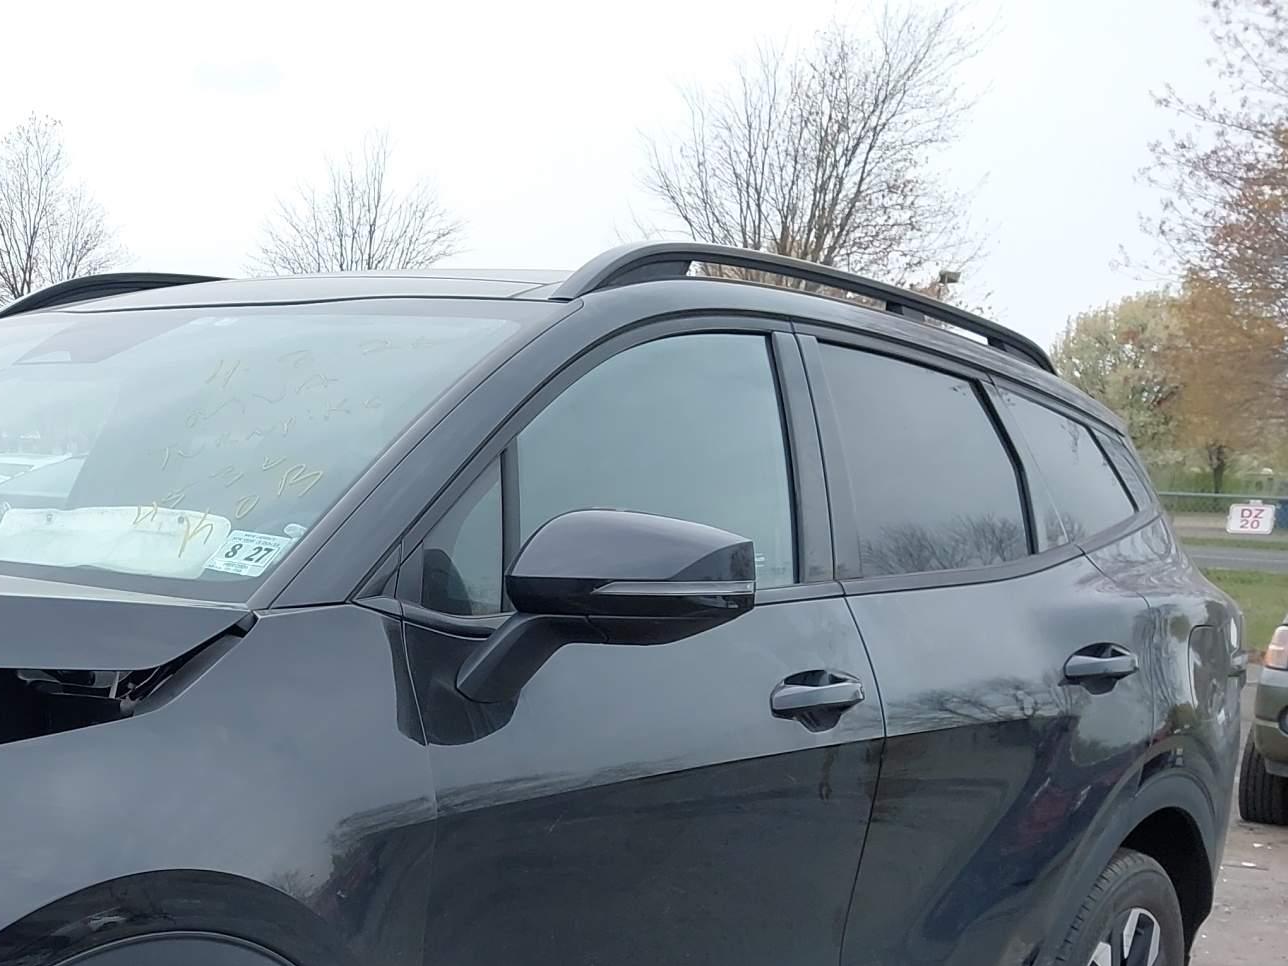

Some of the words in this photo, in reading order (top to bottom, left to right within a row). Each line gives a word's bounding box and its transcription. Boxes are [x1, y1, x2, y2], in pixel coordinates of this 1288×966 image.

[1240, 508, 1265, 519] DZ
[1240, 519, 1261, 529] 20
[224, 543, 244, 559] 8
[243, 545, 275, 563] 27
